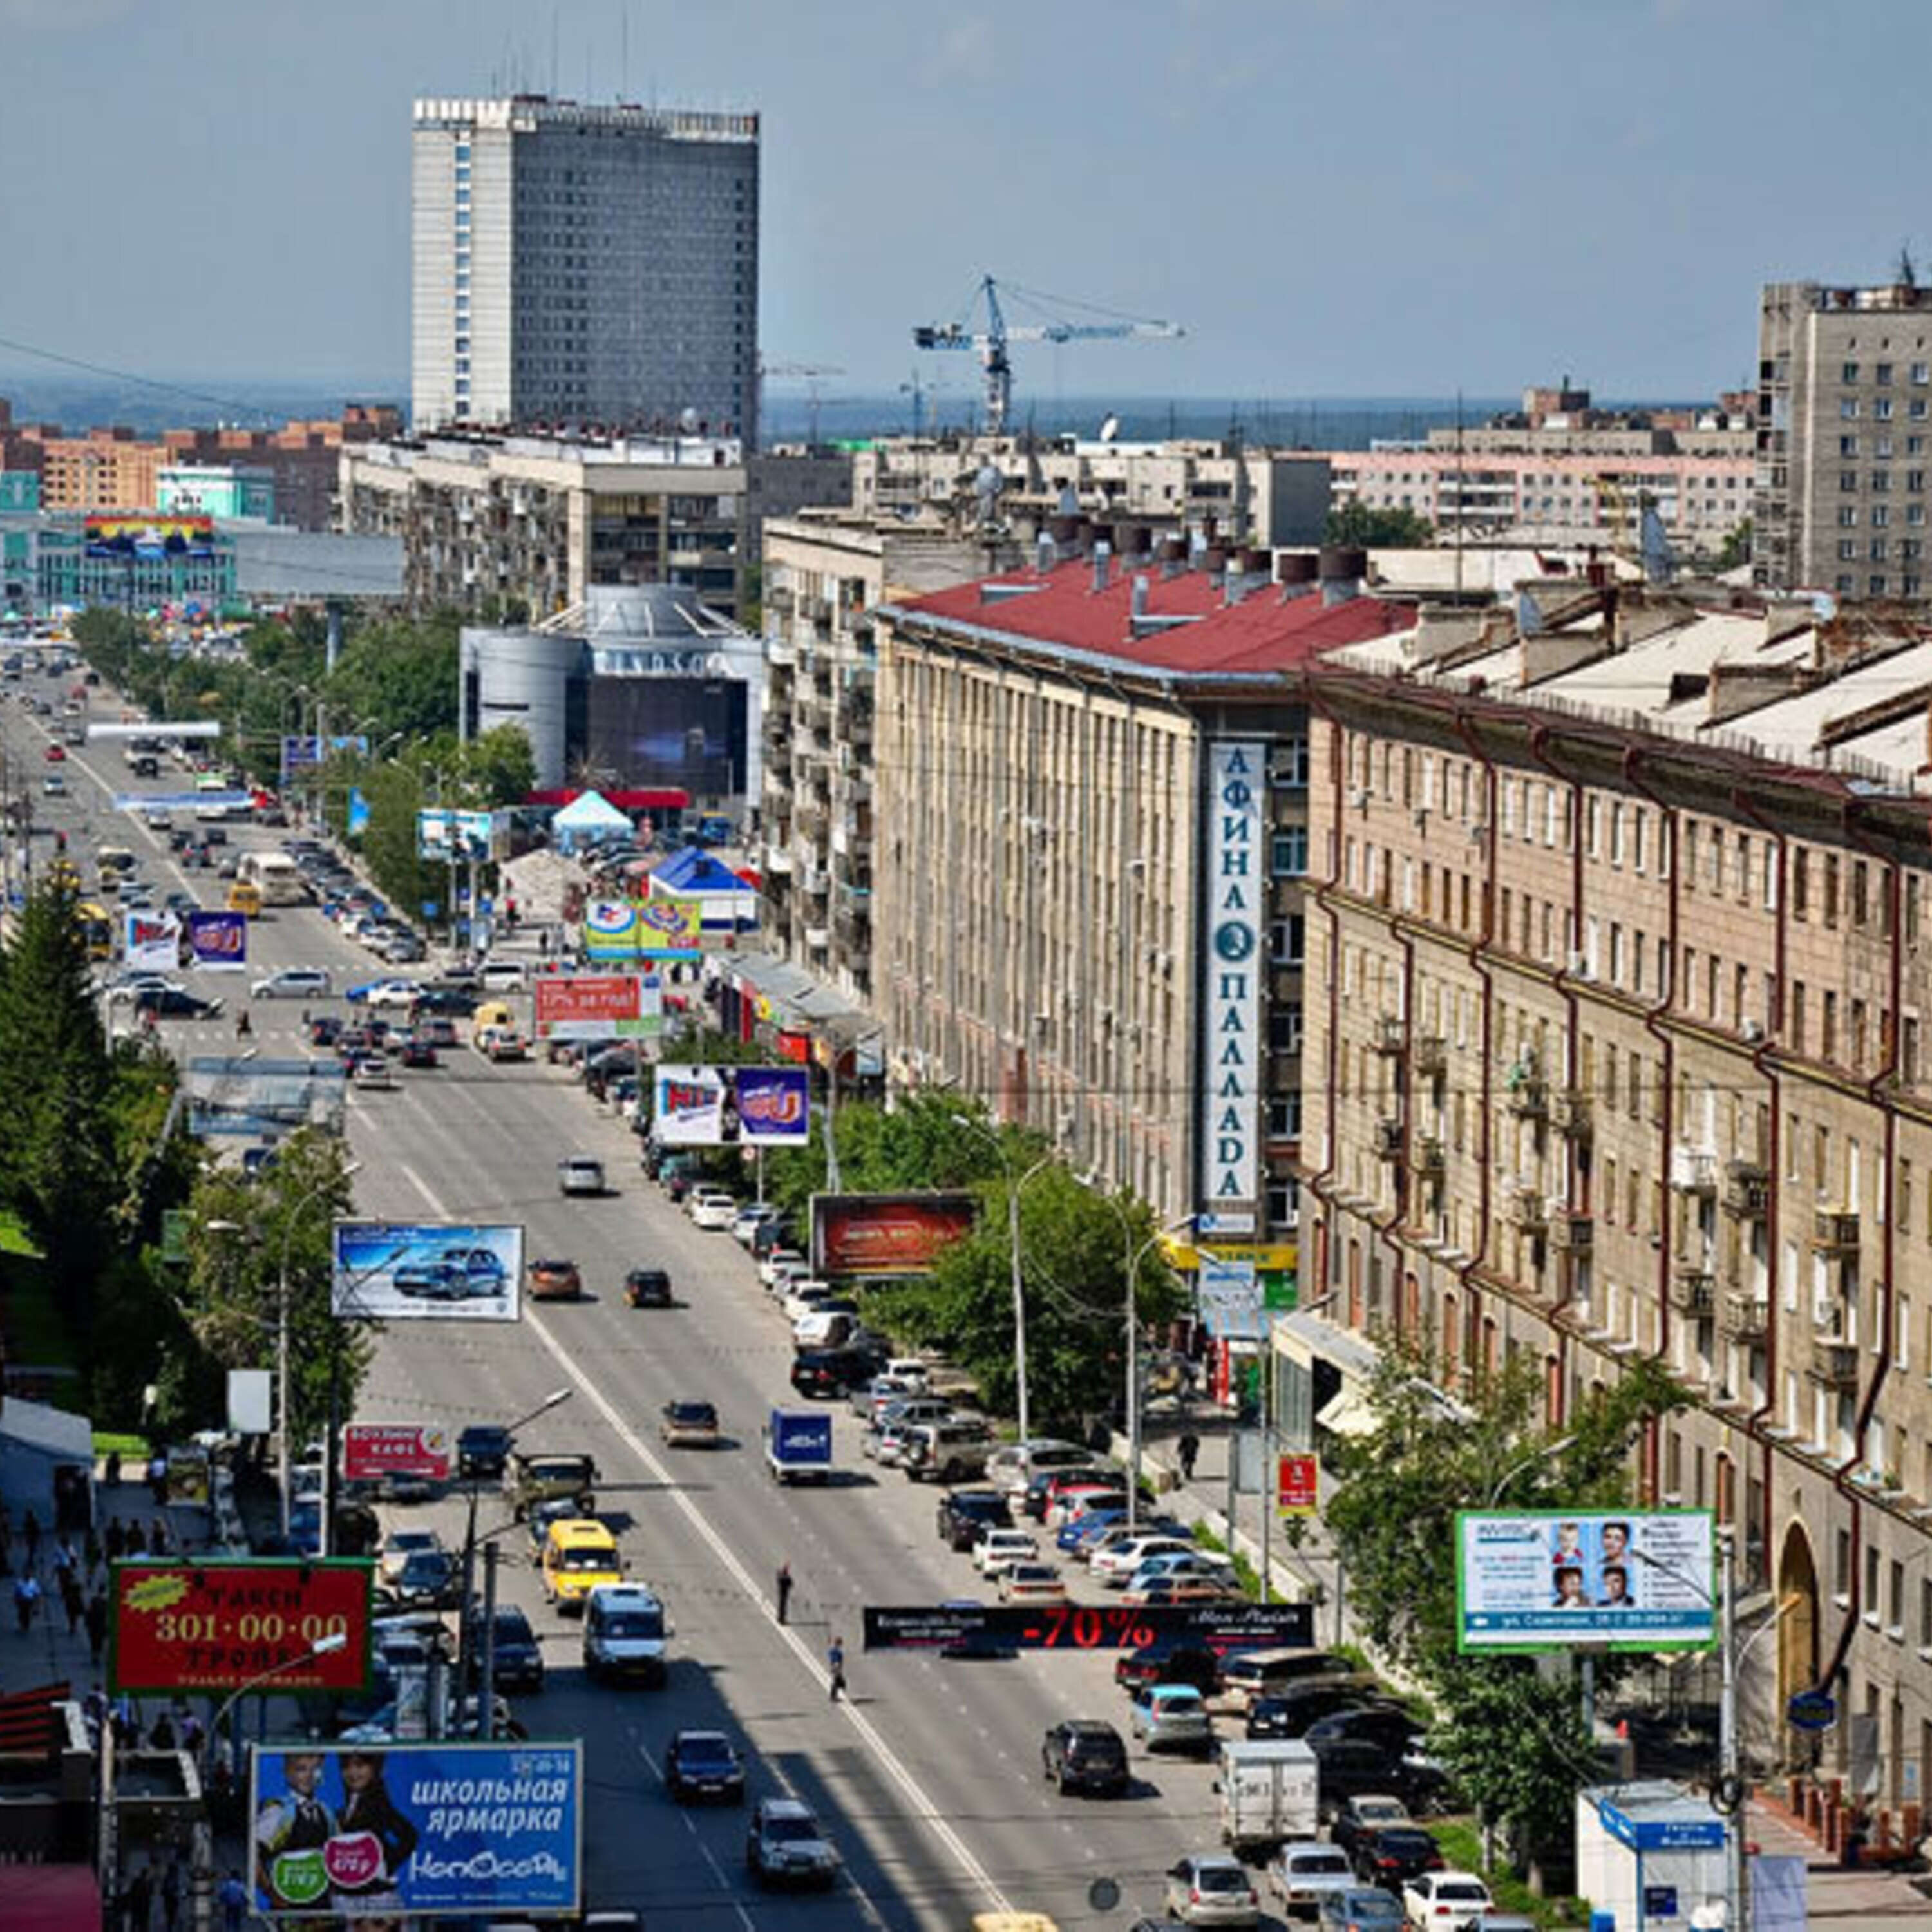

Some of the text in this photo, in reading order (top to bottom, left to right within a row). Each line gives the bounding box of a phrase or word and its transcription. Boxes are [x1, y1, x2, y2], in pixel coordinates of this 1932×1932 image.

[1222, 746, 1251, 909] АФИНА
[1023, 1607, 1154, 1647] -70%
[411, 1778, 567, 1804] школьная
[426, 1807, 563, 1841] ярмарка
